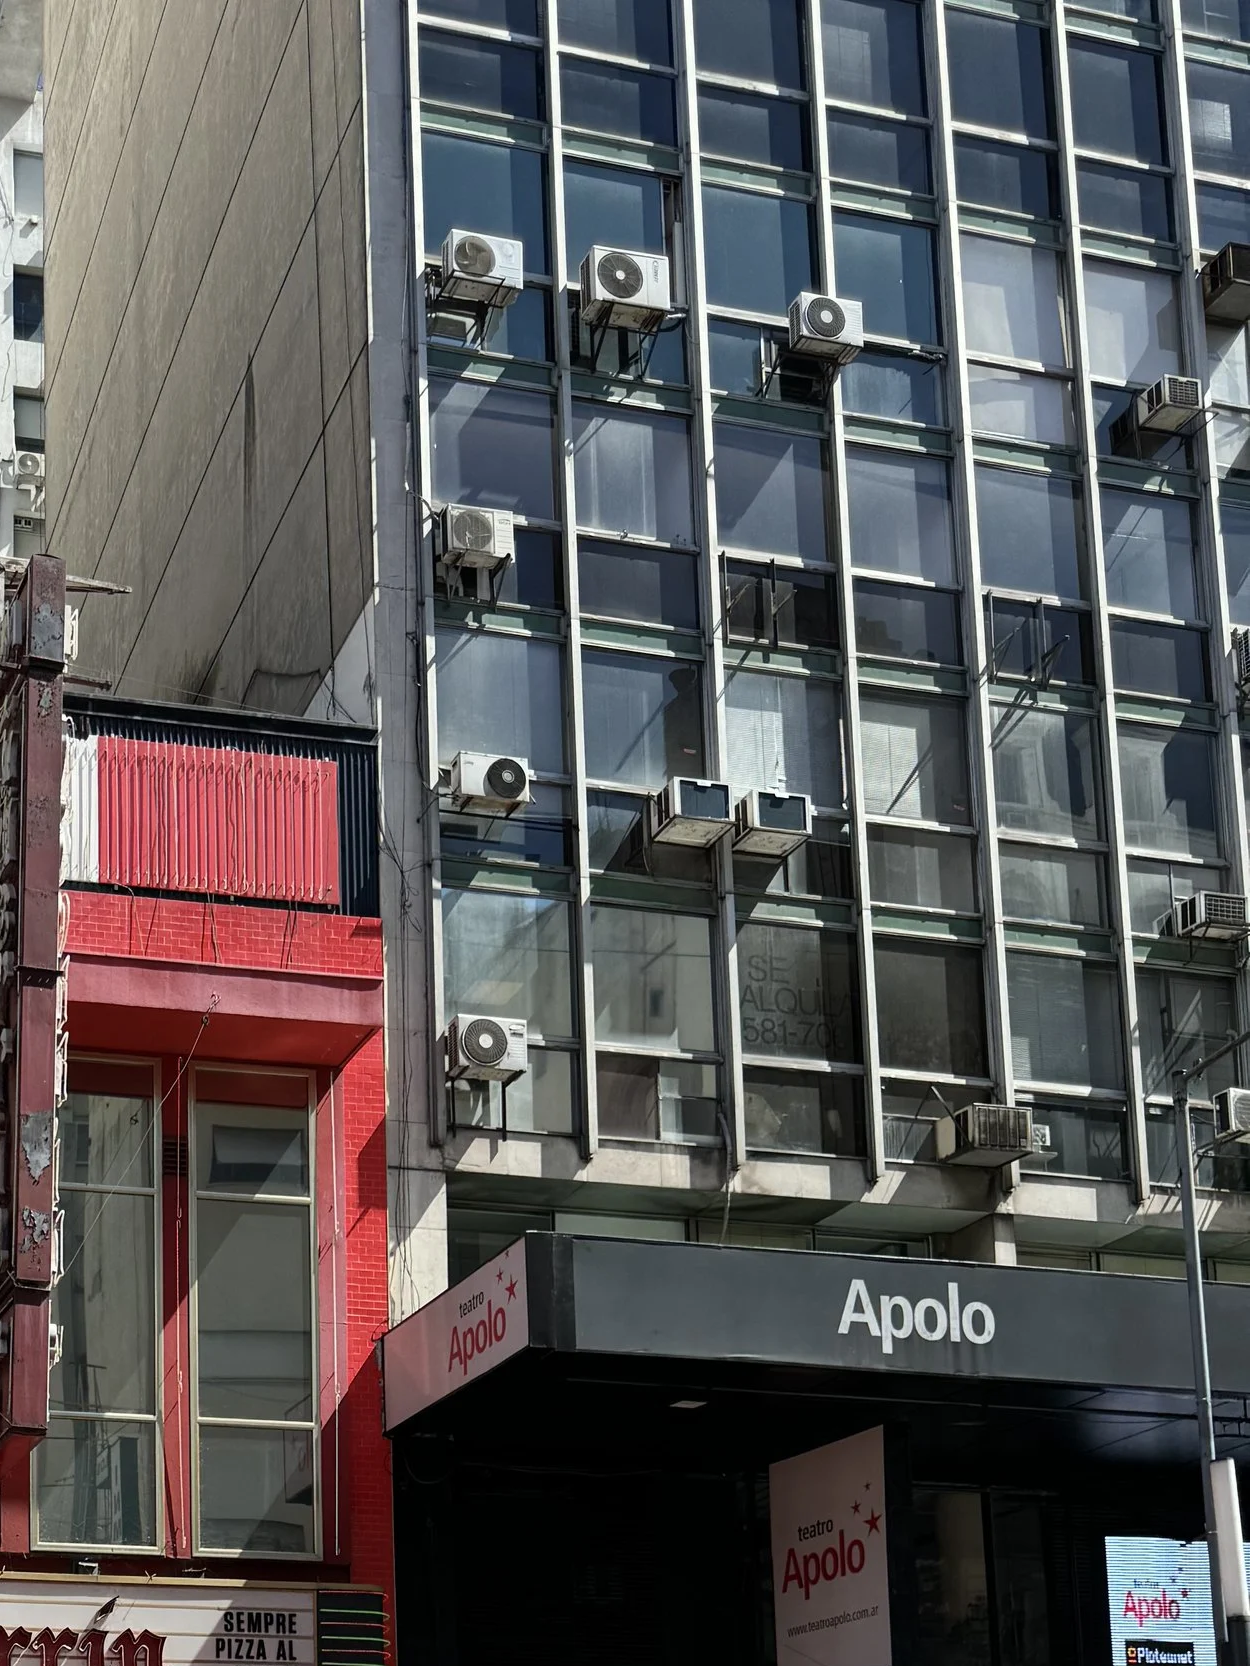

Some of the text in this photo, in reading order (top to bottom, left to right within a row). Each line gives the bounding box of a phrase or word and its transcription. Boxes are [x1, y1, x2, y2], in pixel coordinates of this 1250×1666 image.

[747, 954, 790, 985] SE
[459, 1291, 485, 1318] teatro
[838, 1278, 995, 1354] Apolo
[448, 1299, 506, 1376] Apolo
[798, 1519, 834, 1542] teatro
[782, 1529, 865, 1600] Apolo
[223, 1611, 297, 1635] SEMPRE
[1123, 1588, 1181, 1628] Apolo
[215, 1638, 297, 1661] PIZZA AL
